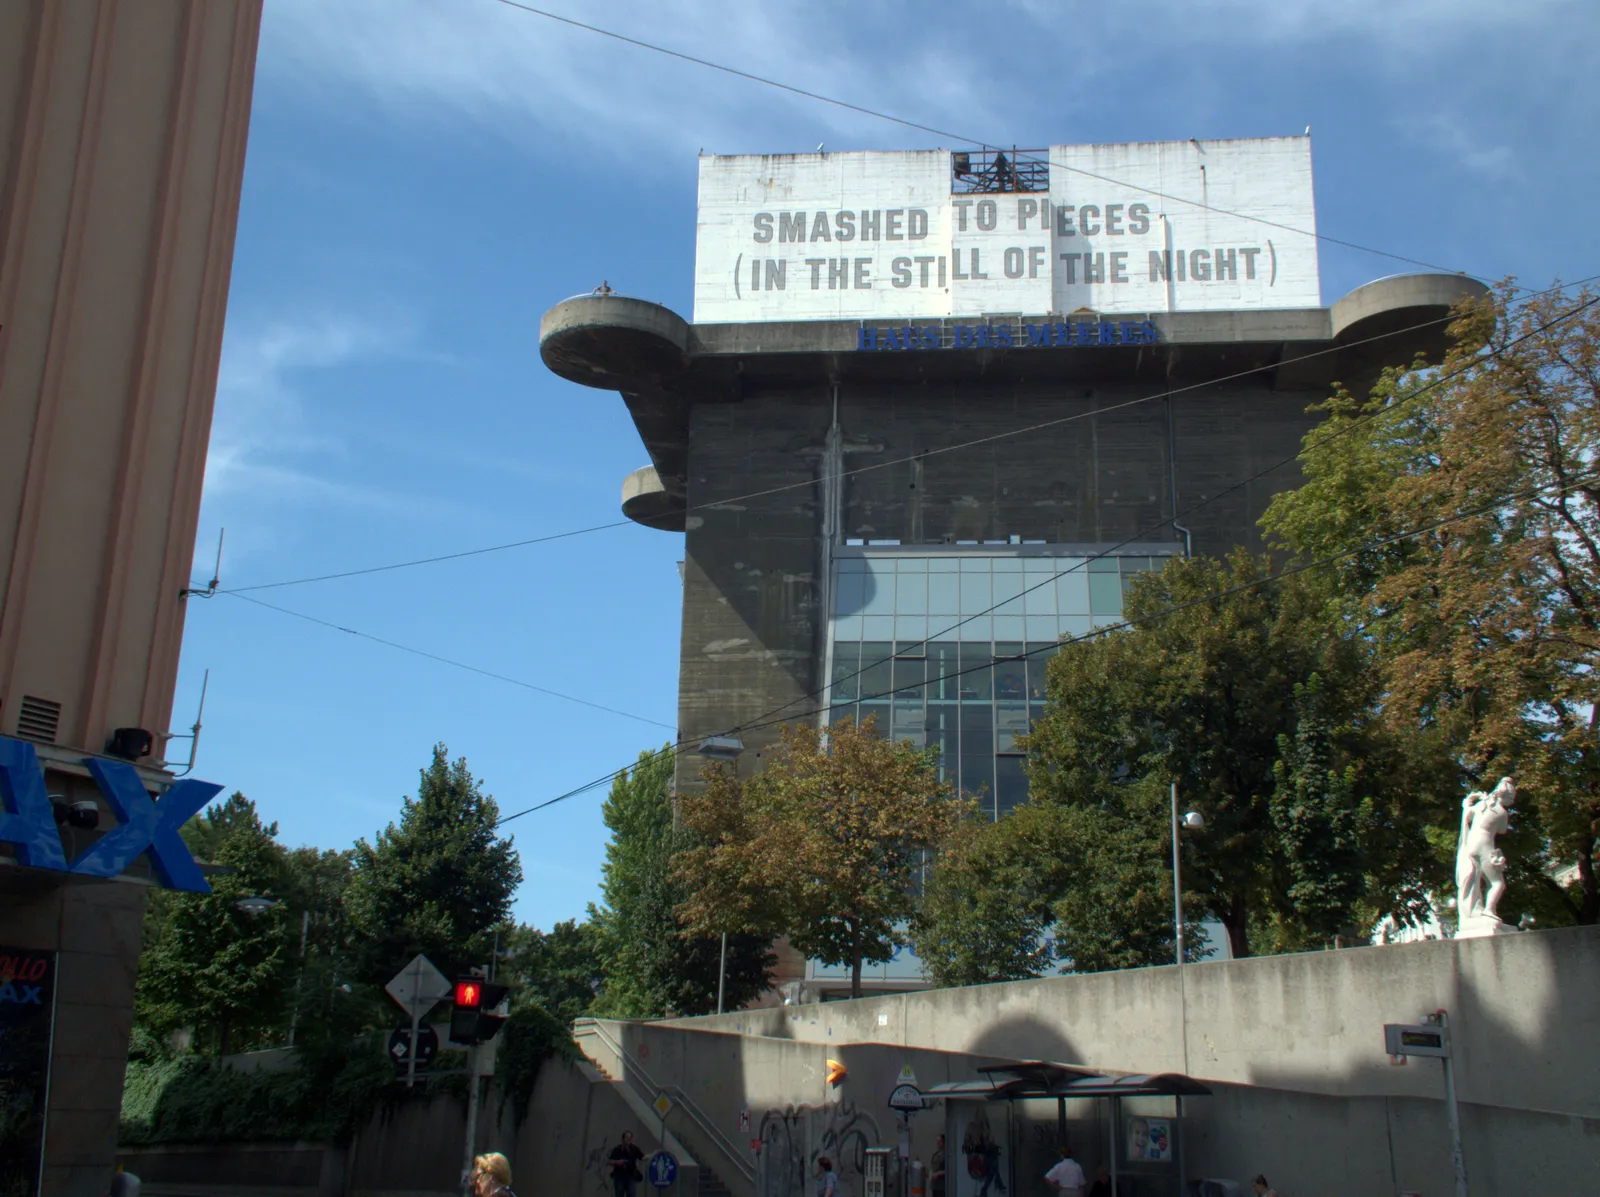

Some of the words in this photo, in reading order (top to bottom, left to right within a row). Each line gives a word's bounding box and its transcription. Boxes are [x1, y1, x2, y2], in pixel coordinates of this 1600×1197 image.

[753, 209, 929, 243] SMASHED
[951, 199, 997, 232] TO
[1017, 198, 1150, 237] PIECES
[734, 252, 787, 300] (IN
[805, 258, 873, 290] THE
[891, 248, 988, 289] STILL
[1003, 246, 1046, 280] OF
[1060, 251, 1129, 285] THE
[1148, 239, 1277, 288] NIGHT)
[856, 326, 941, 350] HAUS
[953, 323, 1012, 349] DES
[1025, 320, 1157, 348] MEERES
